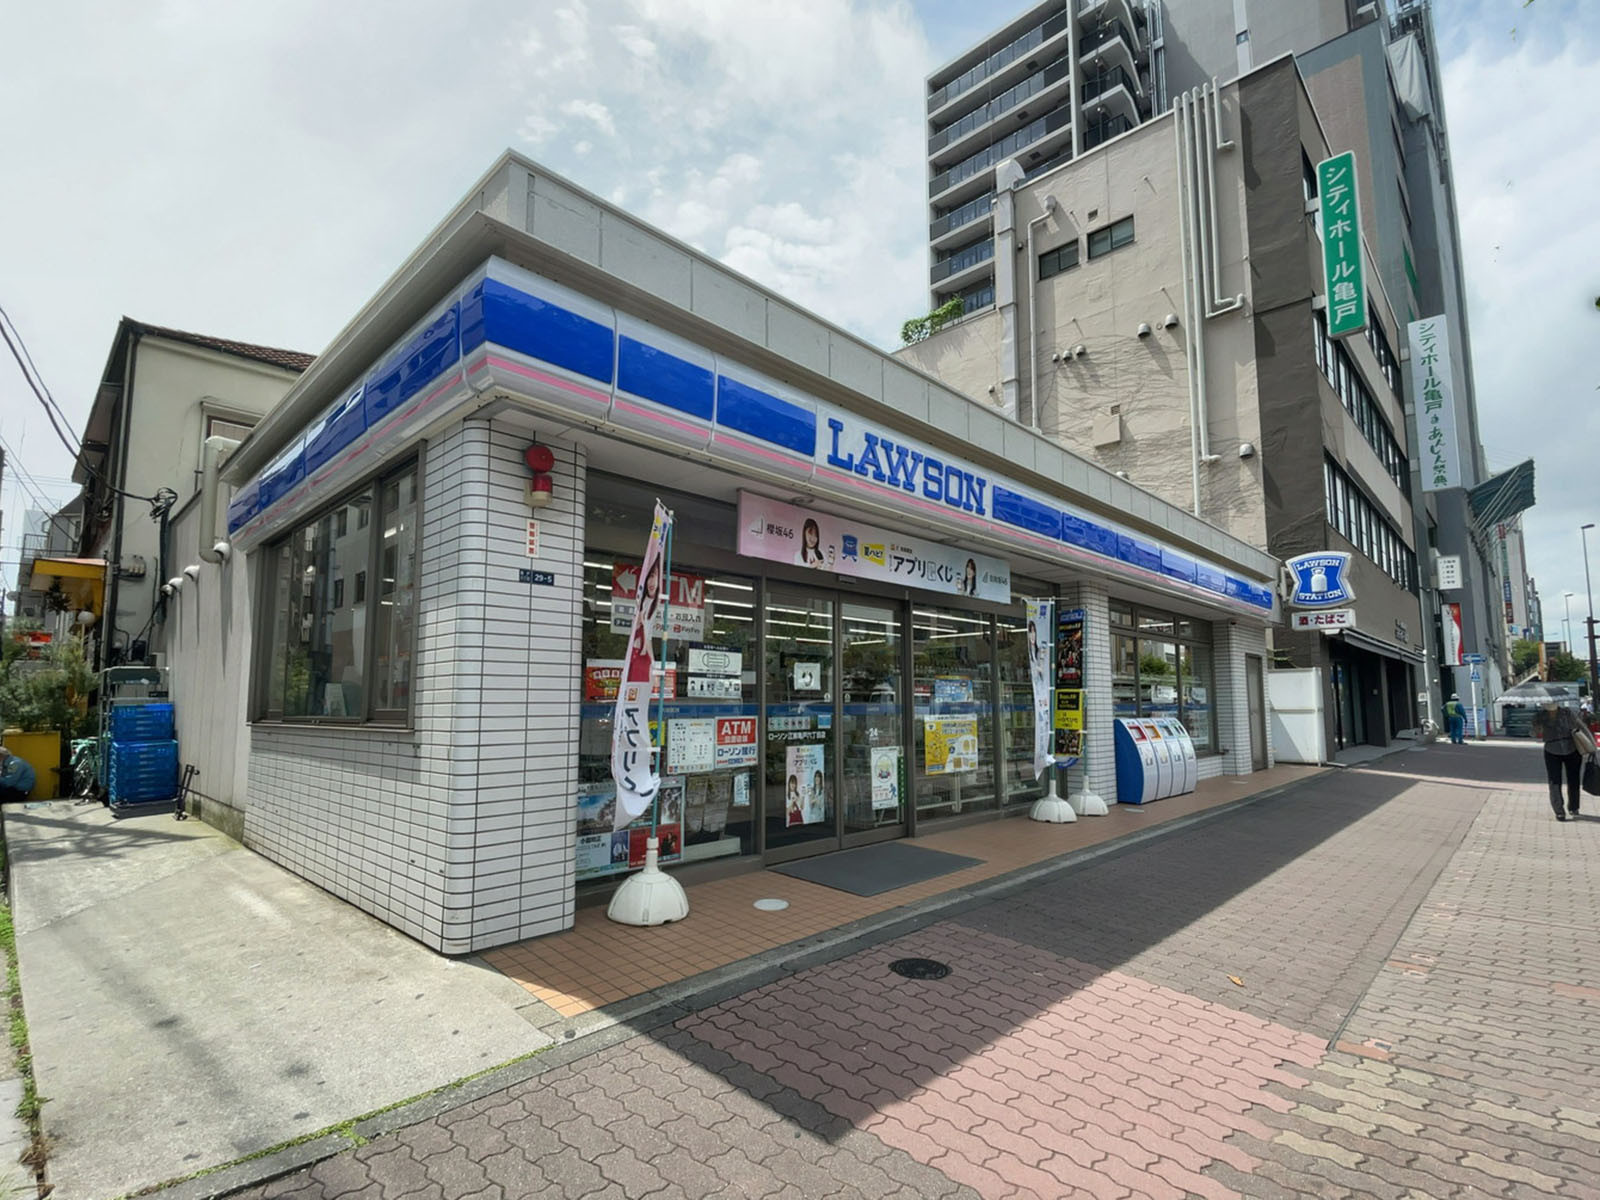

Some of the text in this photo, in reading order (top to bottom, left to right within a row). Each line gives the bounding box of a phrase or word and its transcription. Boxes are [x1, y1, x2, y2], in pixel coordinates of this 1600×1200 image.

[1325, 166, 1358, 325] シティホール亀戸
[827, 418, 987, 516] LAWSON
[1296, 559, 1340, 570] LAWSON
[1299, 589, 1342, 600] STATION
[721, 721, 751, 735] ATM
